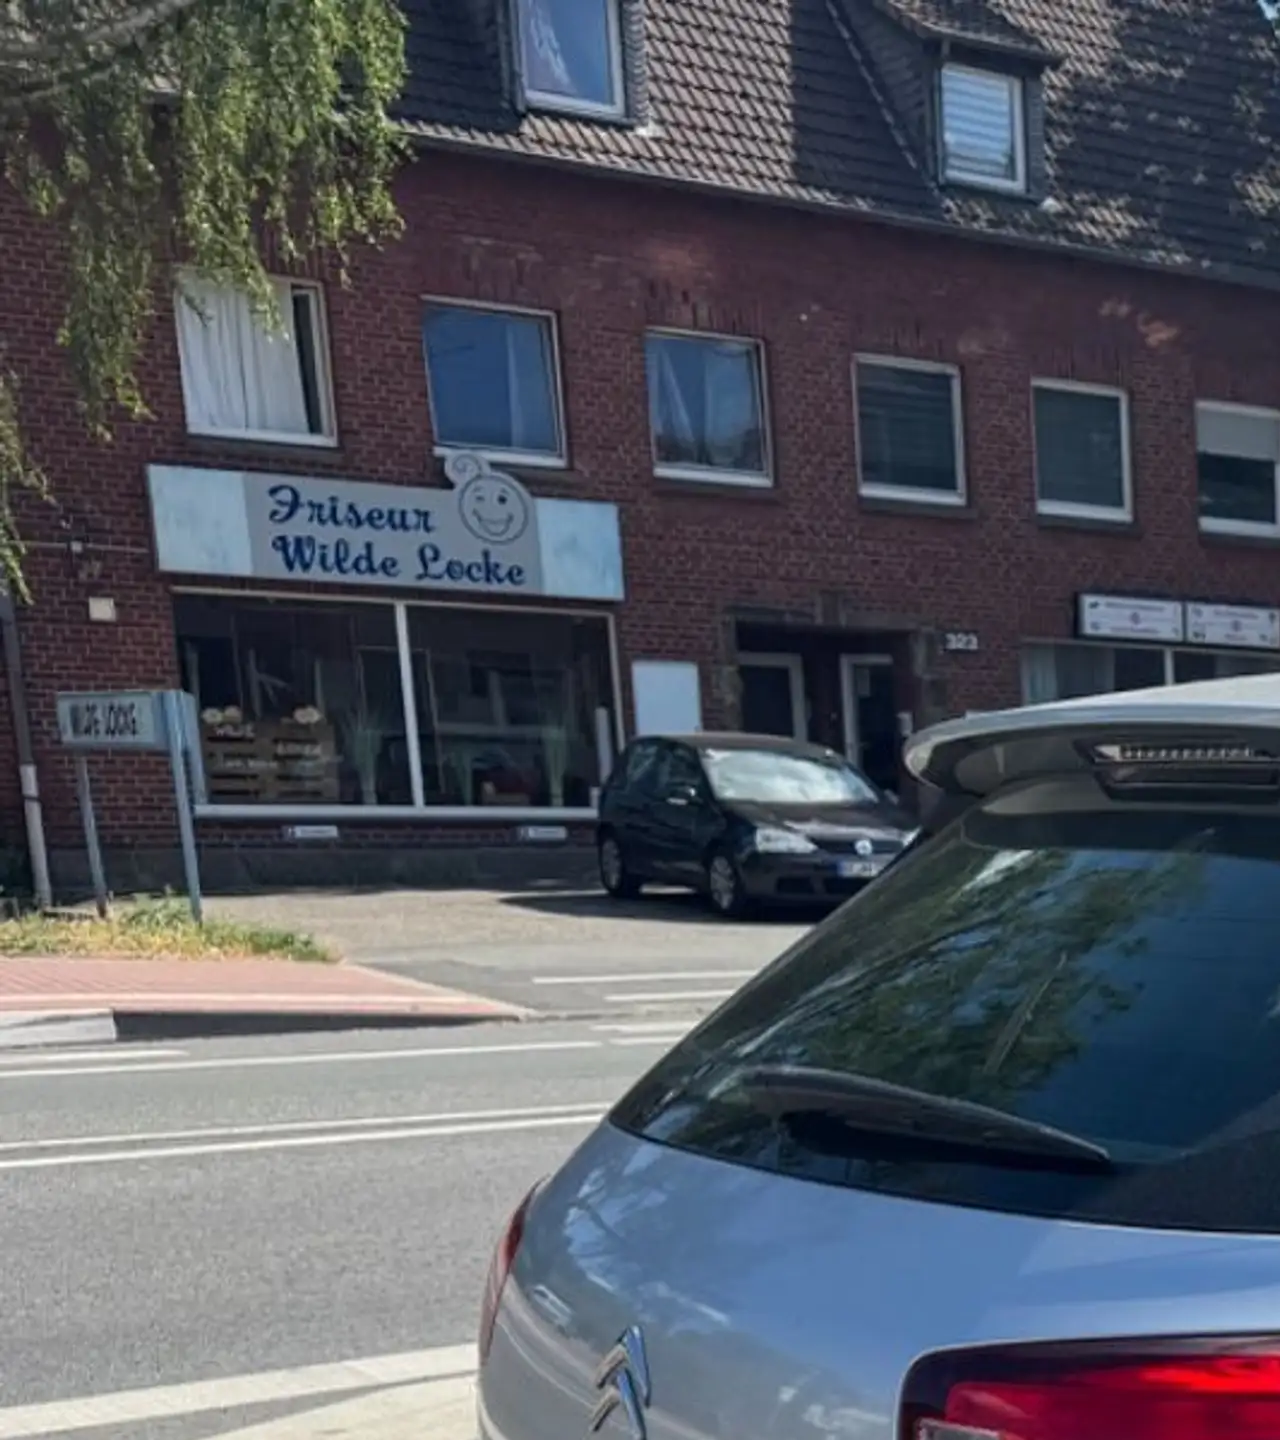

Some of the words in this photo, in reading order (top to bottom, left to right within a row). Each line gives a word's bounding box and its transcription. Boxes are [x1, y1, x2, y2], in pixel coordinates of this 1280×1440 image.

[268, 484, 436, 533] Friseur
[271, 535, 402, 578] Wilde
[414, 542, 526, 586] Locke
